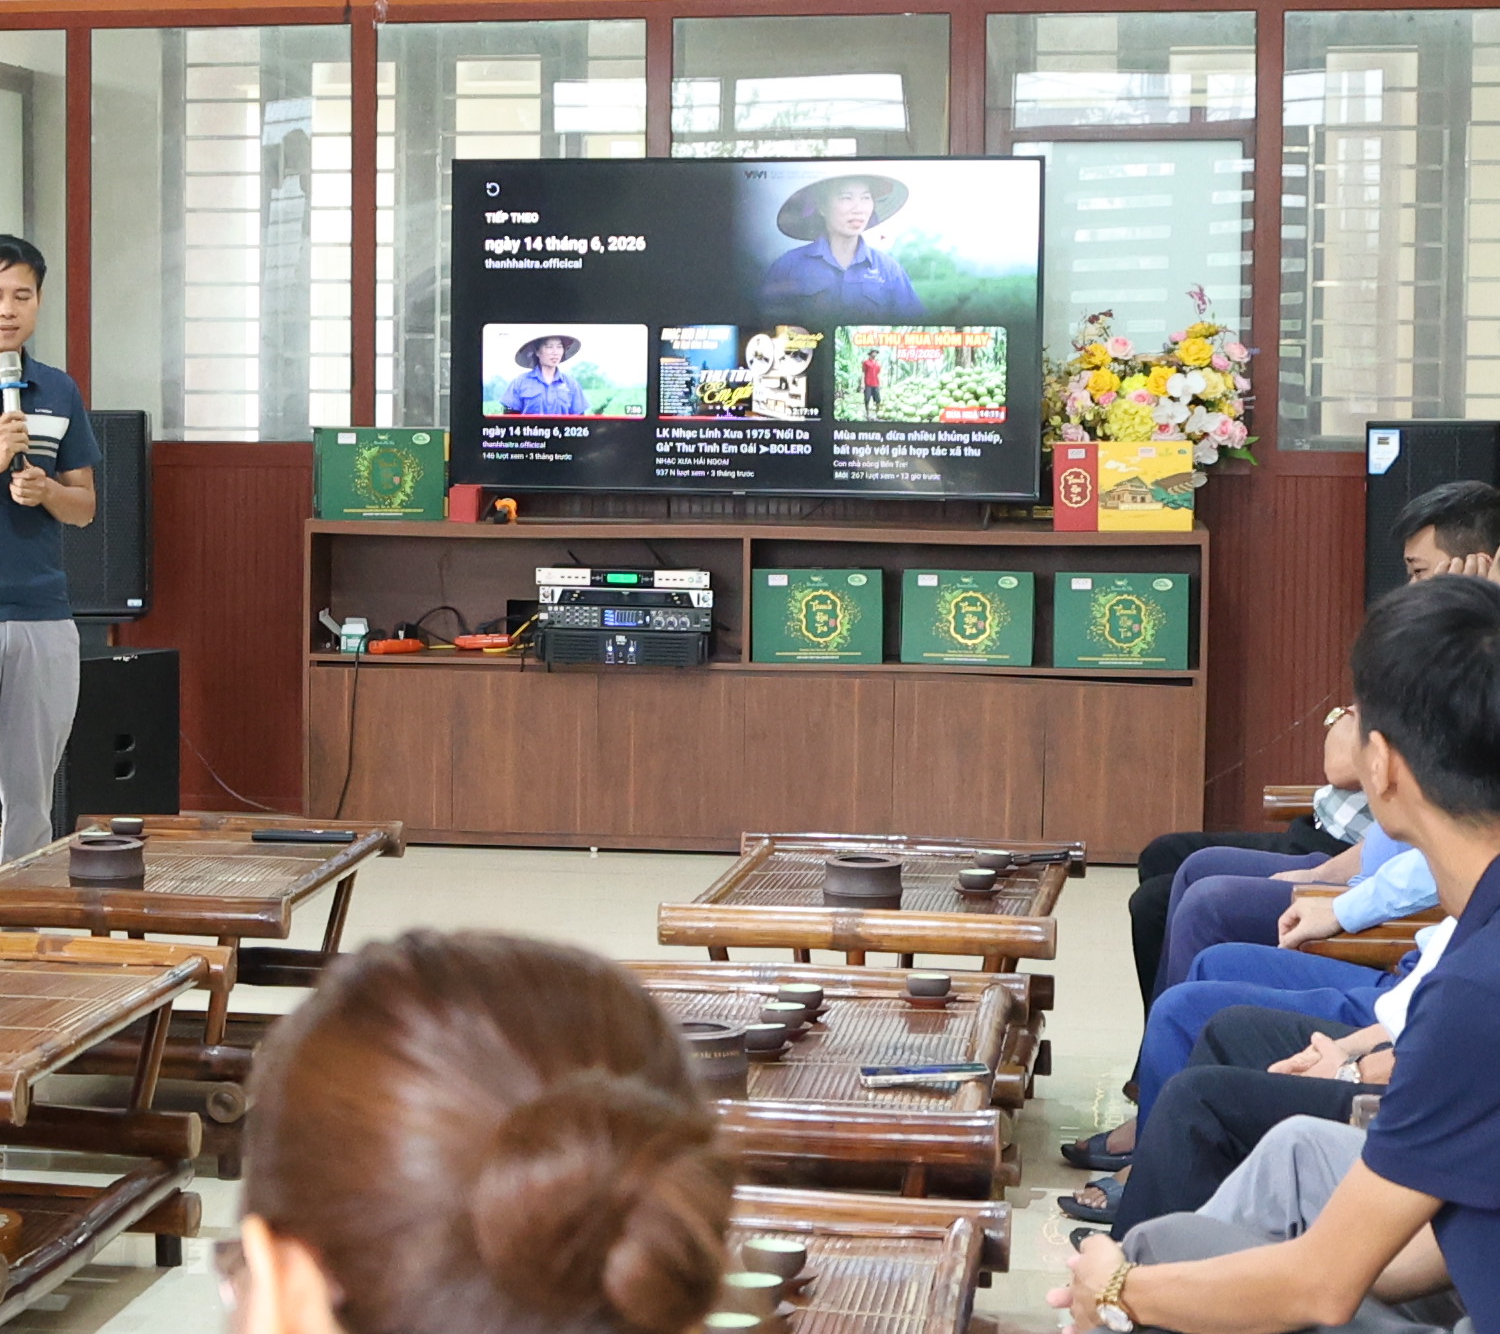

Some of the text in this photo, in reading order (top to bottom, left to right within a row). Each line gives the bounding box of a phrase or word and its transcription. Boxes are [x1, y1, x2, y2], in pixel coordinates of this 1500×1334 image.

[485, 209, 540, 224] TIẾP THEO
[484, 236, 646, 254] ngày 14 tháng 6, 2026
[877, 333, 901, 345] THU
[904, 333, 932, 345] MUA
[934, 332, 962, 345] HÔM
[965, 333, 990, 345] NAY
[482, 426, 589, 438] ngày 14 tháng 6, 2026
[656, 428, 670, 438] LK
[672, 428, 697, 440] Nhạc
[700, 428, 721, 439] Lính
[723, 429, 743, 439] Xưa
[746, 429, 770, 439] 1975
[796, 429, 810, 439] Da
[833, 430, 856, 440] Mùa
[858, 431, 884, 442] mưa,
[907, 430, 935, 441] nhiều
[938, 430, 969, 443] khủng
[971, 430, 1002, 444] khiếp,
[676, 442, 696, 453] Thư
[699, 442, 720, 453] Tình
[722, 443, 738, 453] Em
[740, 442, 757, 453] Gái
[833, 444, 981, 458] bất ngờ với giá hợp tác xã thu
